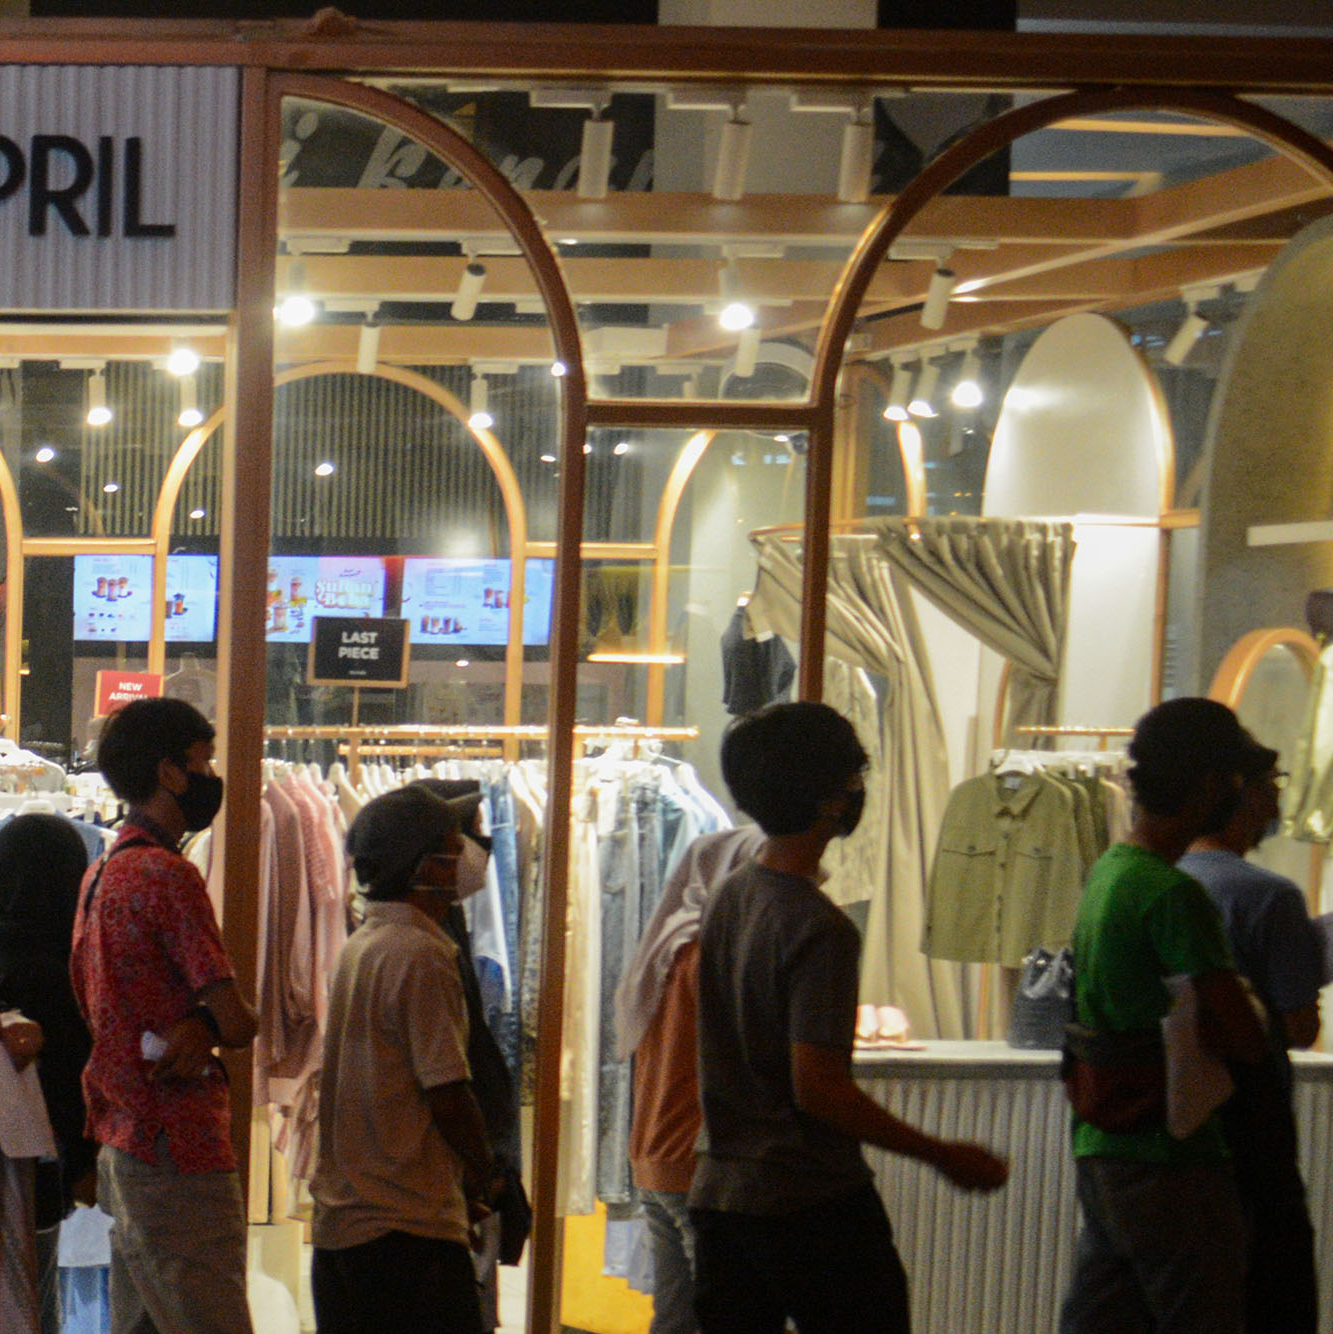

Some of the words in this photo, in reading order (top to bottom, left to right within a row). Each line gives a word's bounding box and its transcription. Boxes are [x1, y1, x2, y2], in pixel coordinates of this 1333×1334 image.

[341, 631, 379, 644] LAST
[337, 646, 381, 660] PIECE
[118, 682, 143, 692] NEW
